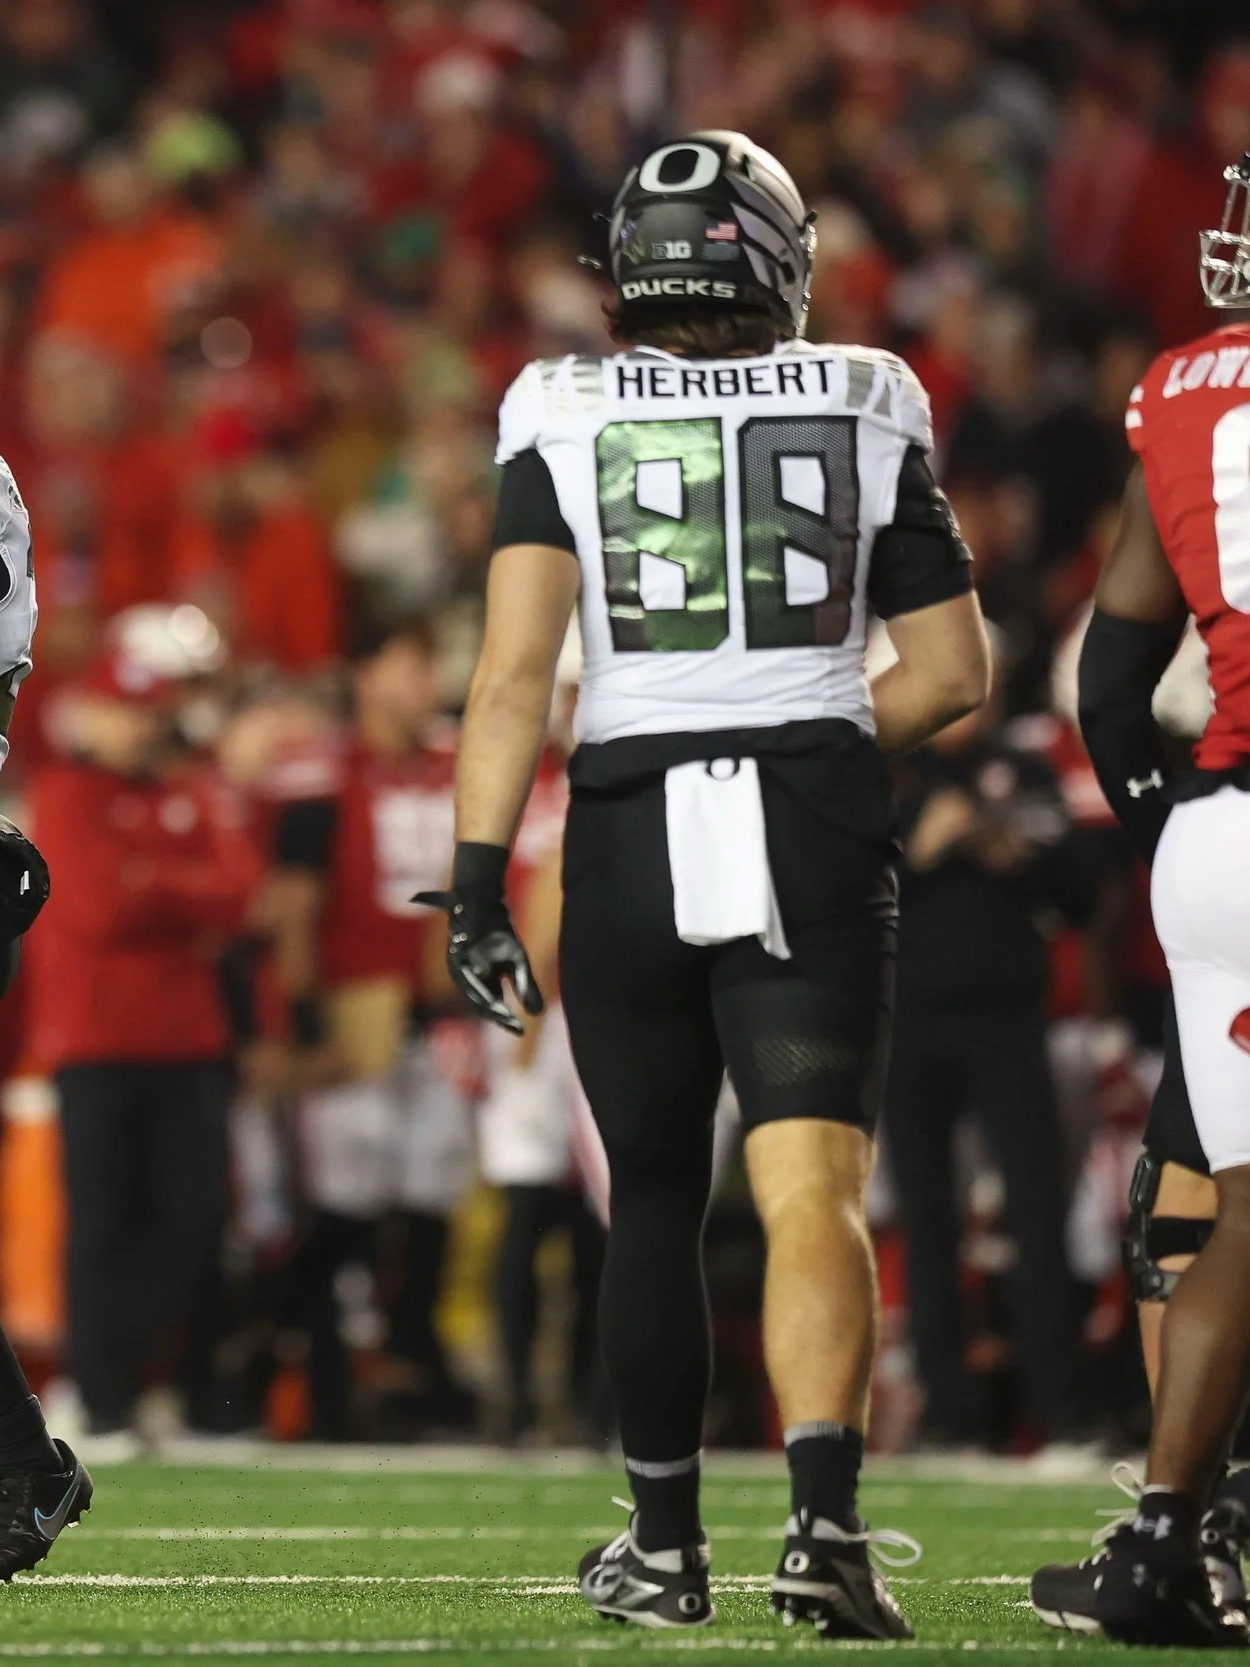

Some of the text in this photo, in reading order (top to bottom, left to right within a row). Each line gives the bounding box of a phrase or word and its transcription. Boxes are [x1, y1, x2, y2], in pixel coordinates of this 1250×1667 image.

[639, 142, 721, 193] O
[621, 277, 737, 300] DUCKS
[617, 359, 835, 399] HERBERT
[595, 414, 862, 653] 88
